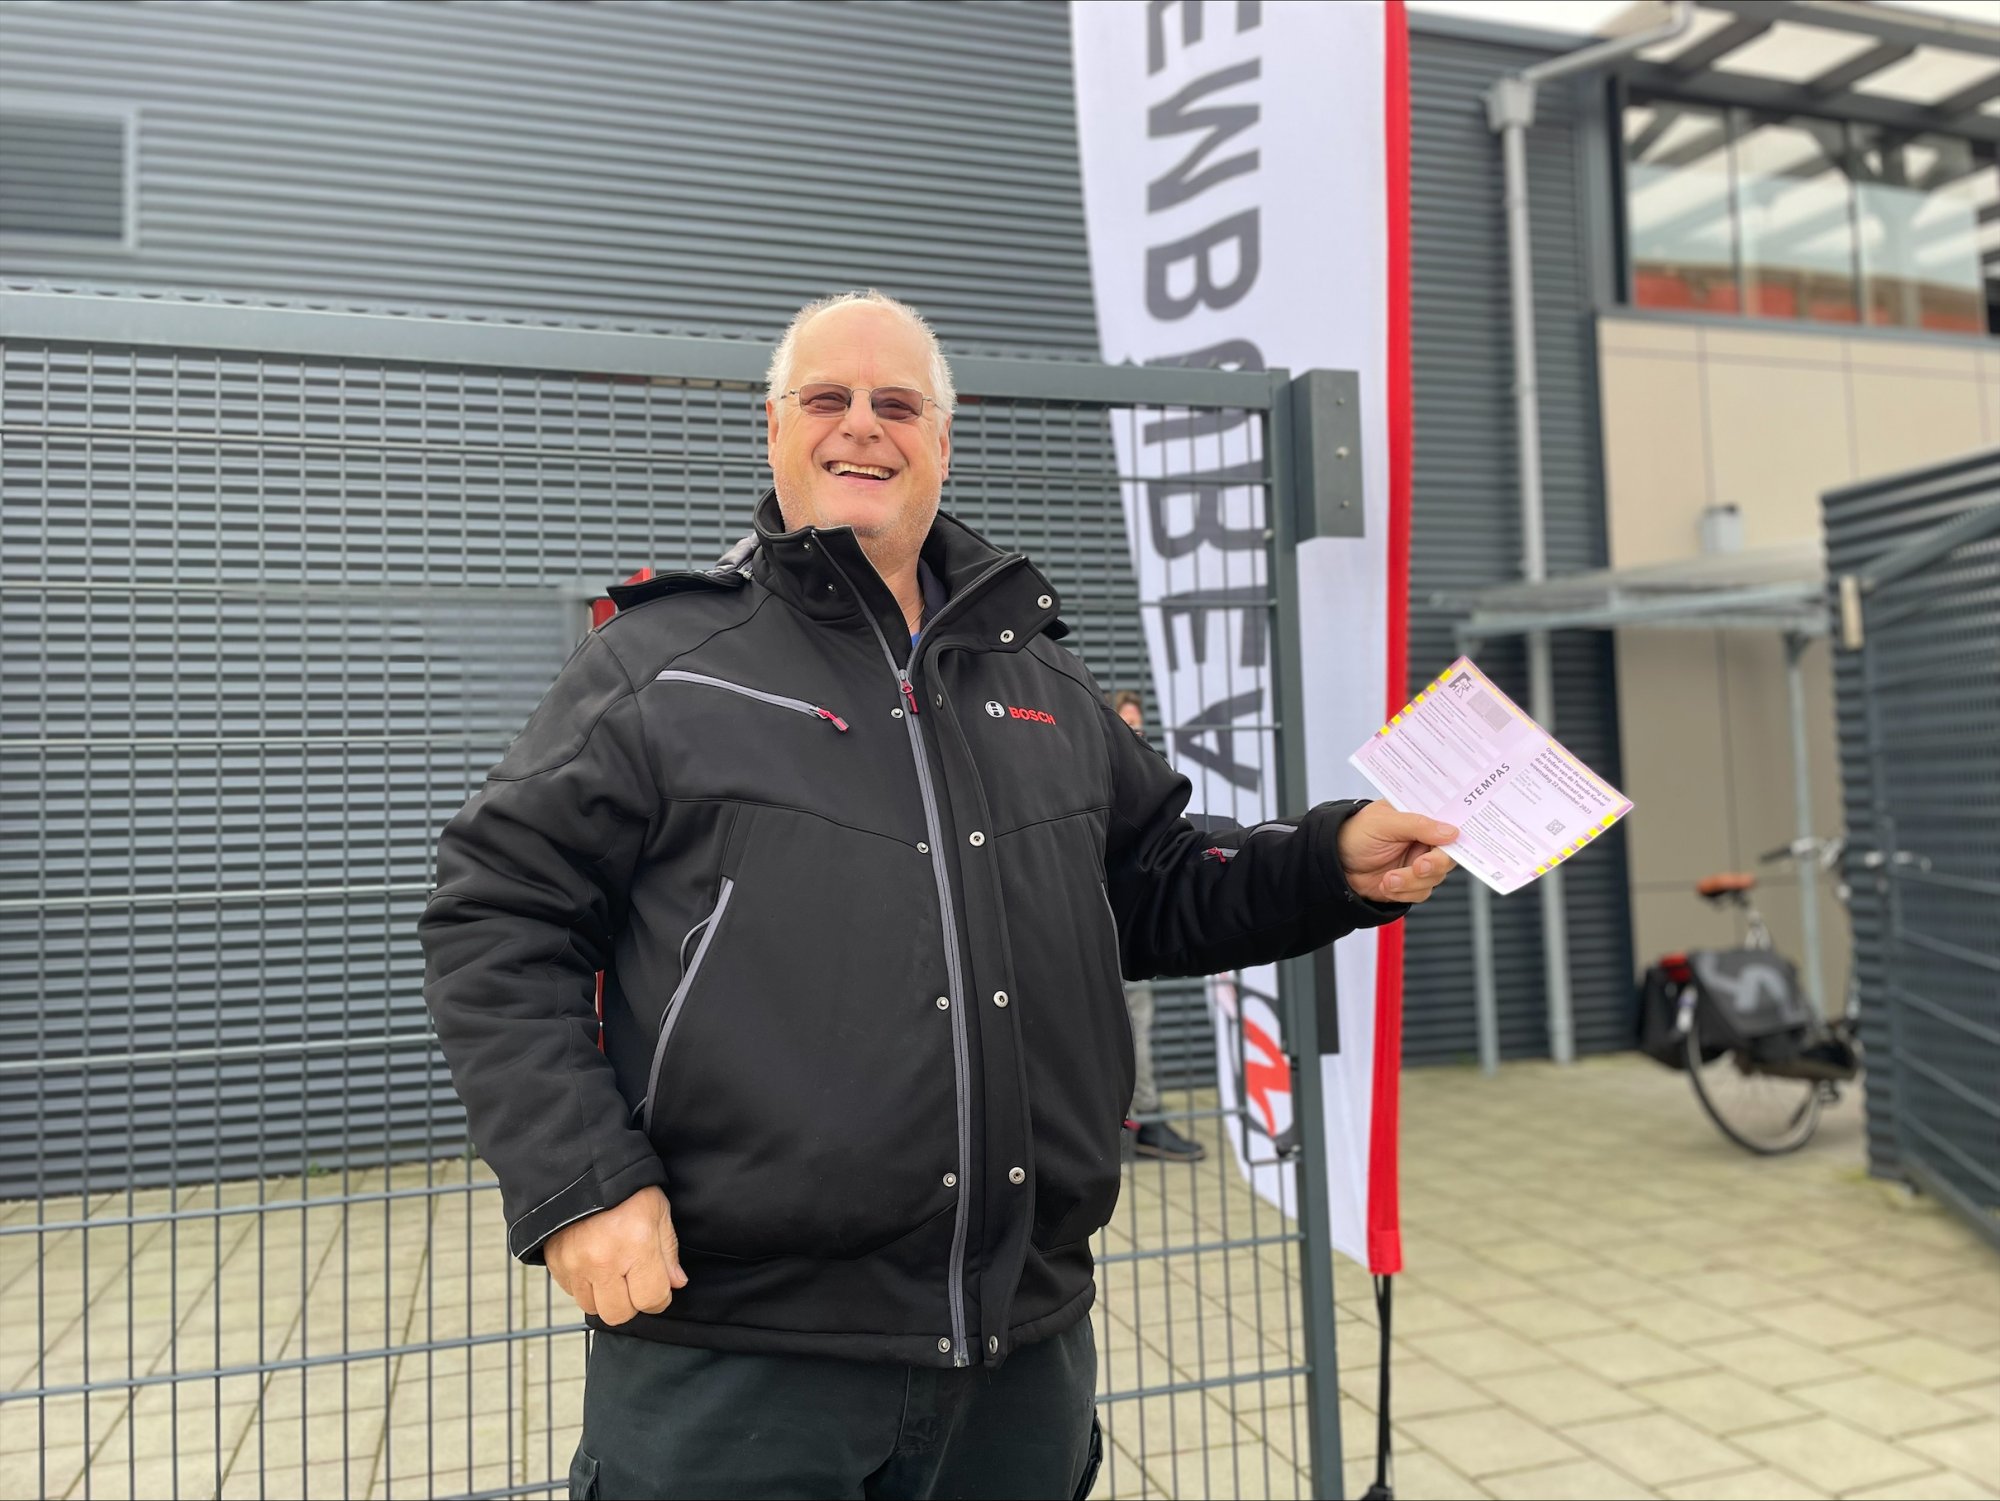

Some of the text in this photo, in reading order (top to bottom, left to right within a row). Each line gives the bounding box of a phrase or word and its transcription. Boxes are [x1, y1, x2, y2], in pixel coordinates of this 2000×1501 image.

[1008, 706, 1056, 726] BOSCH
[1463, 762, 1511, 806] STEMPAS
[1529, 762, 1552, 783] woensdag
[1557, 786, 1579, 804] november
[1545, 747, 1563, 763] Oproep
[1578, 776, 1602, 796] verkiezing
[1546, 757, 1559, 769] leden
[1573, 779, 1590, 795] Tweede
[1590, 793, 1605, 806] Kamer
